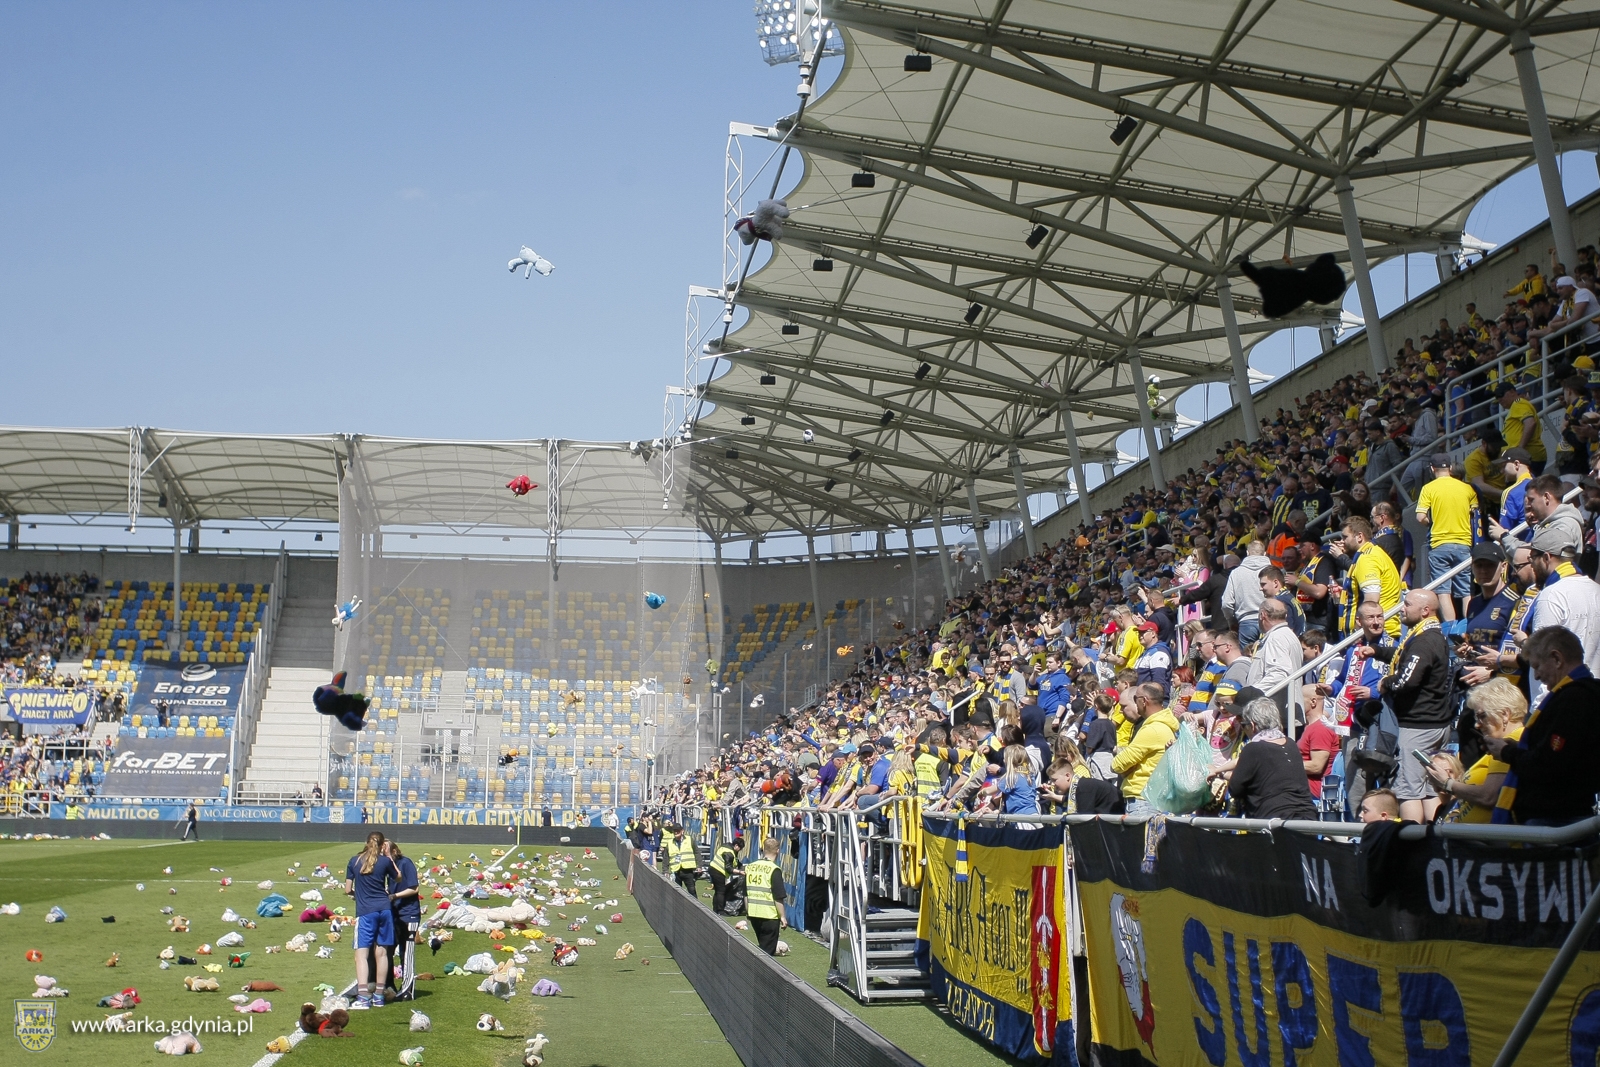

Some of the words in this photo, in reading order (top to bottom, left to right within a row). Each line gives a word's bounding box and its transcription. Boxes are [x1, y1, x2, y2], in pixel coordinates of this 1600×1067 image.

[154, 682, 231, 697] Energa
[21, 709, 51, 719] ZNACZY
[53, 709, 75, 719] ARKA
[112, 750, 227, 770] forBET
[87, 807, 160, 820] MULTILOG
[203, 808, 231, 818] MOJE
[1300, 851, 1340, 912] NA
